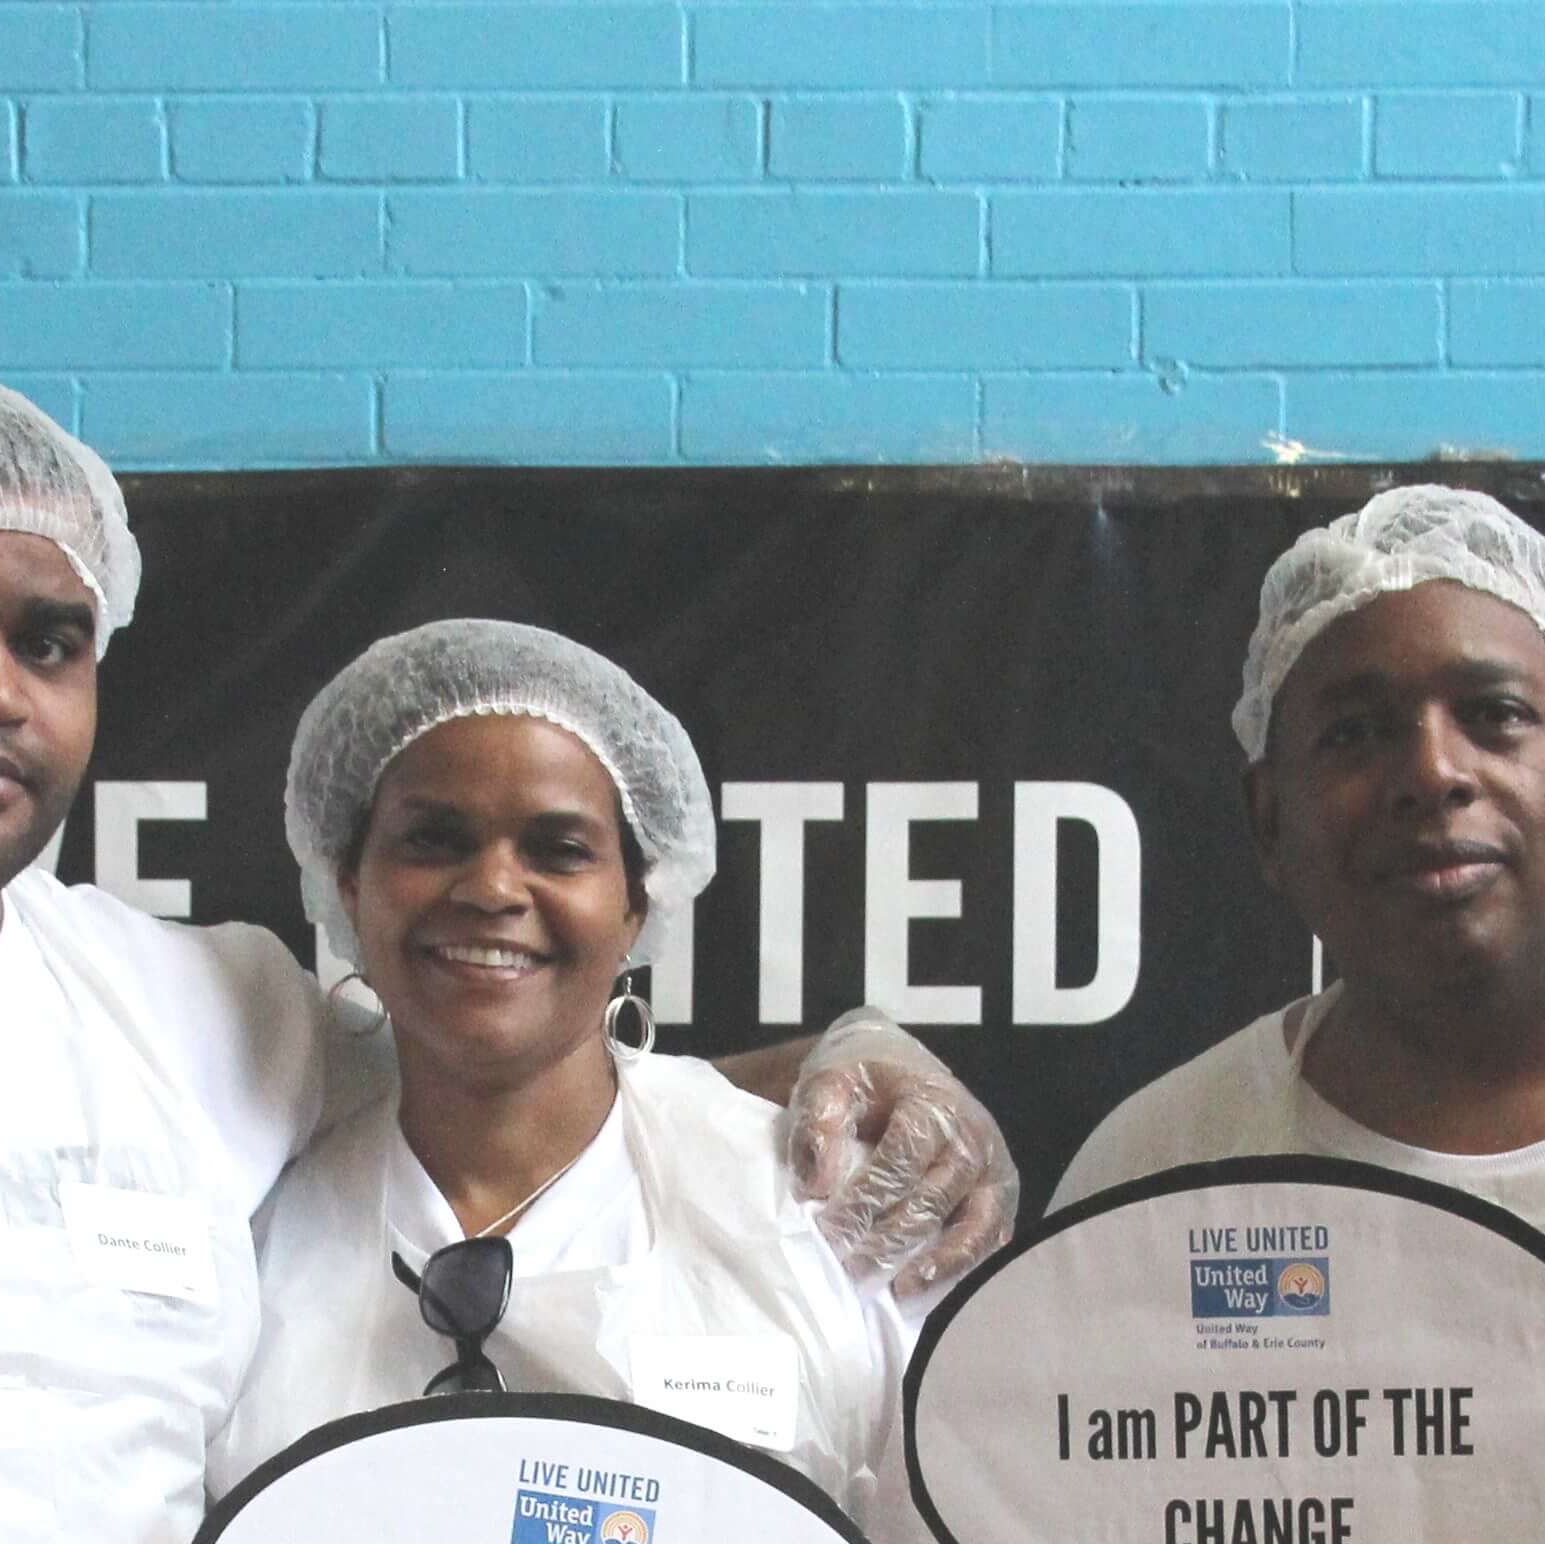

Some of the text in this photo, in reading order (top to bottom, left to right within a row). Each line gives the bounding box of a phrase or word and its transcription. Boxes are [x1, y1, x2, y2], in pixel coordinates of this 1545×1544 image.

[97, 1233, 187, 1256] Dante Collier
[1189, 1226, 1329, 1253] LIVE UNITED
[1194, 1264, 1269, 1286] United
[1224, 1288, 1269, 1313] Way
[1196, 1323, 1258, 1336] United Way
[1196, 1339, 1207, 1349] of
[1263, 1337, 1284, 1348] Erie
[1287, 1336, 1326, 1350] County
[664, 1378, 775, 1398] Kerima Collier
[1057, 1387, 1474, 1460] I am PART OF THE
[519, 1459, 660, 1502] LIVE UNITED
[519, 1496, 593, 1527] United
